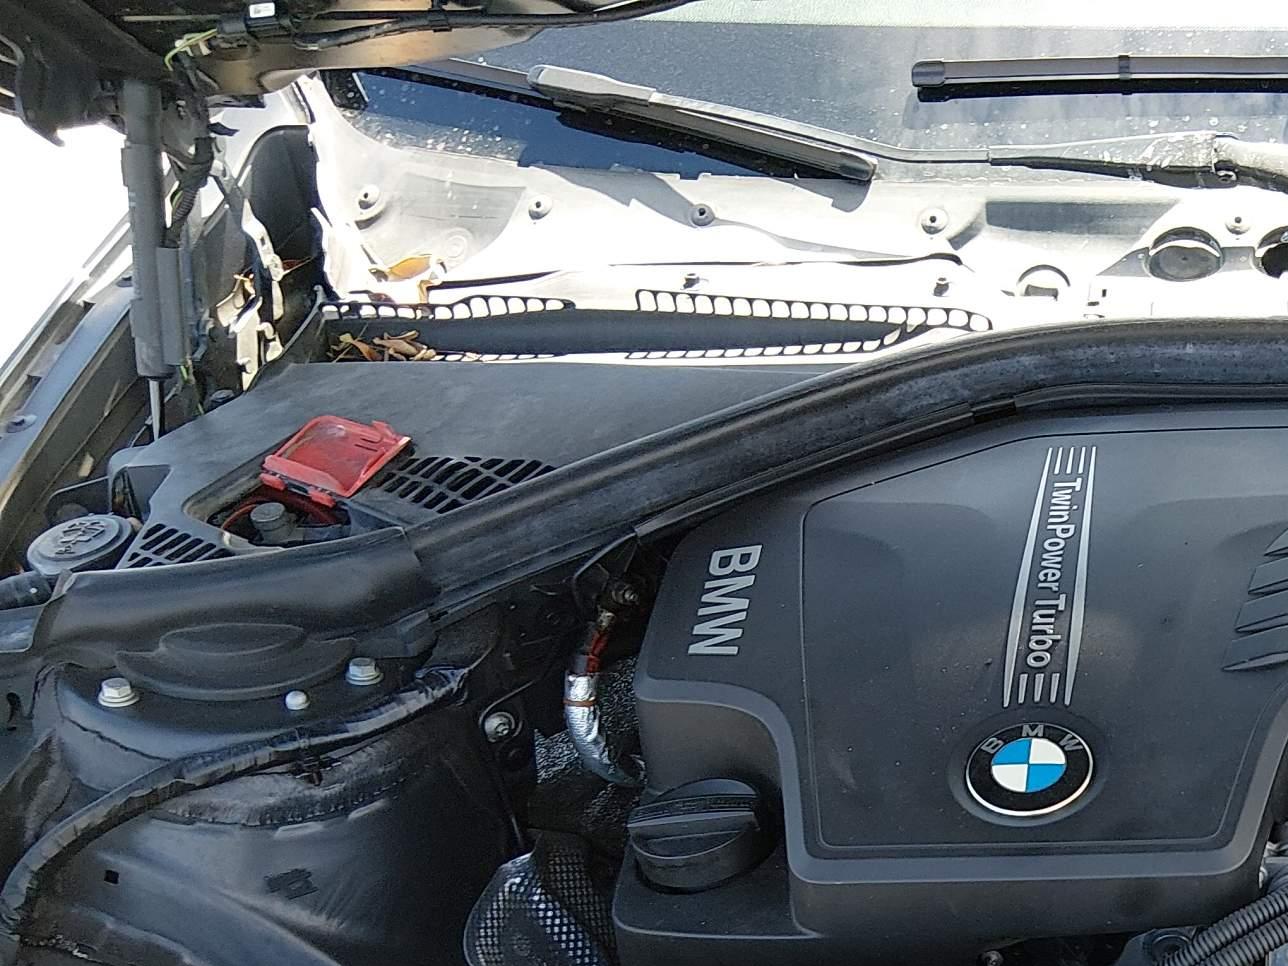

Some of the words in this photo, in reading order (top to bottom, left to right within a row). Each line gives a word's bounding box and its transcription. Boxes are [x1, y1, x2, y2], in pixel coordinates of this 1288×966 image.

[1037, 477, 1083, 591] TwinPower
[687, 544, 763, 656] BMW
[1026, 594, 1067, 669] Turbo
[980, 723, 1084, 755] BMW
